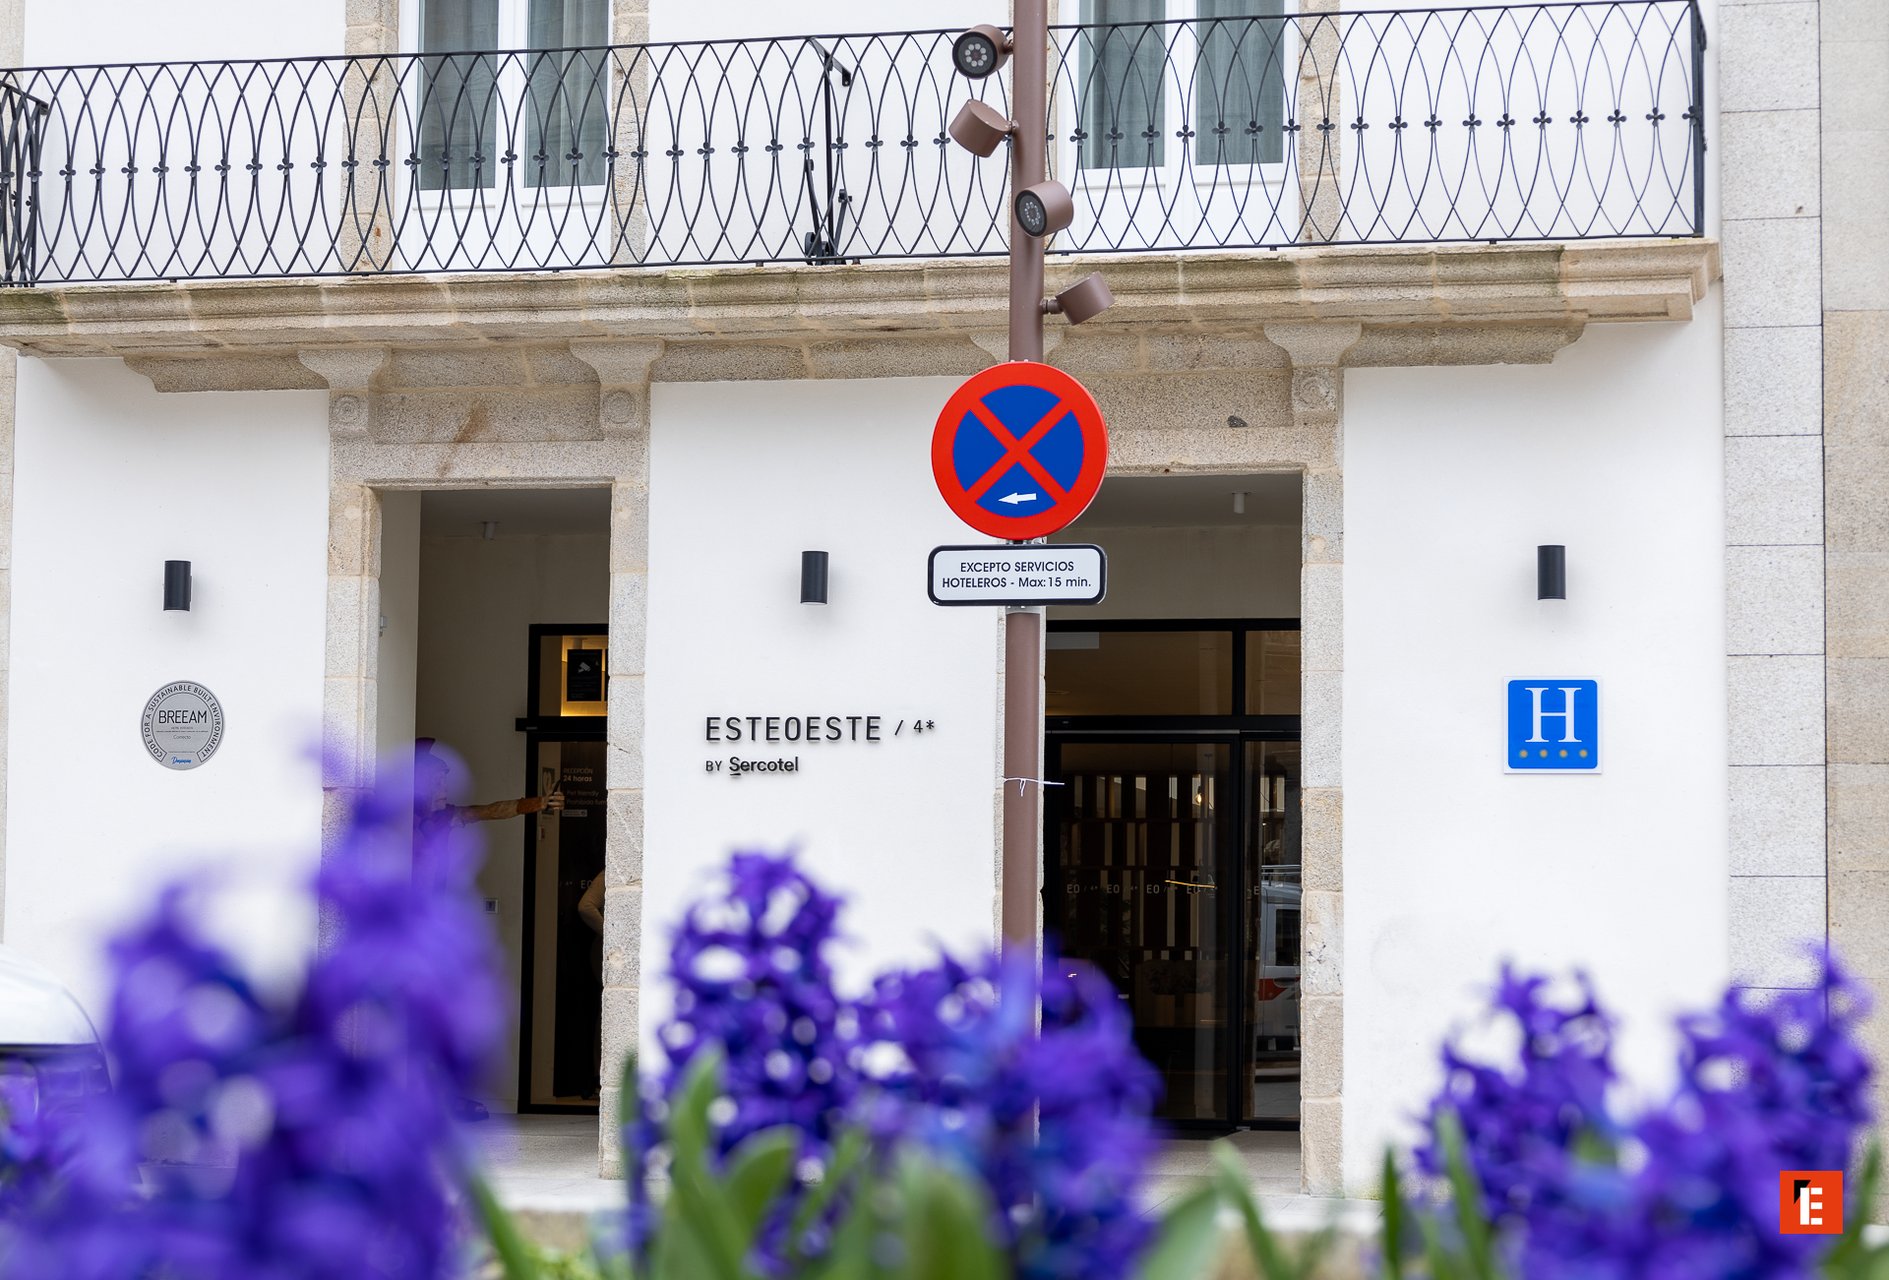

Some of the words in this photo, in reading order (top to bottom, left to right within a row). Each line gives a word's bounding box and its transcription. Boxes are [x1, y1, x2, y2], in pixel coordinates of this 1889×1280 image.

[960, 562, 1011, 573] EXCEPTO
[1014, 561, 1074, 572] SERVICIOS
[942, 577, 1007, 588] HOTELEROS
[1066, 577, 1091, 587] min.
[148, 685, 192, 711] SUSTAINABLE
[193, 687, 212, 702] BUILT
[158, 710, 207, 724] BREEAM
[1525, 687, 1582, 742] H
[202, 702, 221, 757] ENVIRONMENT
[705, 716, 882, 742] ESTEOESTE
[147, 738, 163, 758] CODE
[705, 760, 723, 772] BY
[729, 756, 799, 776] Sercotel
